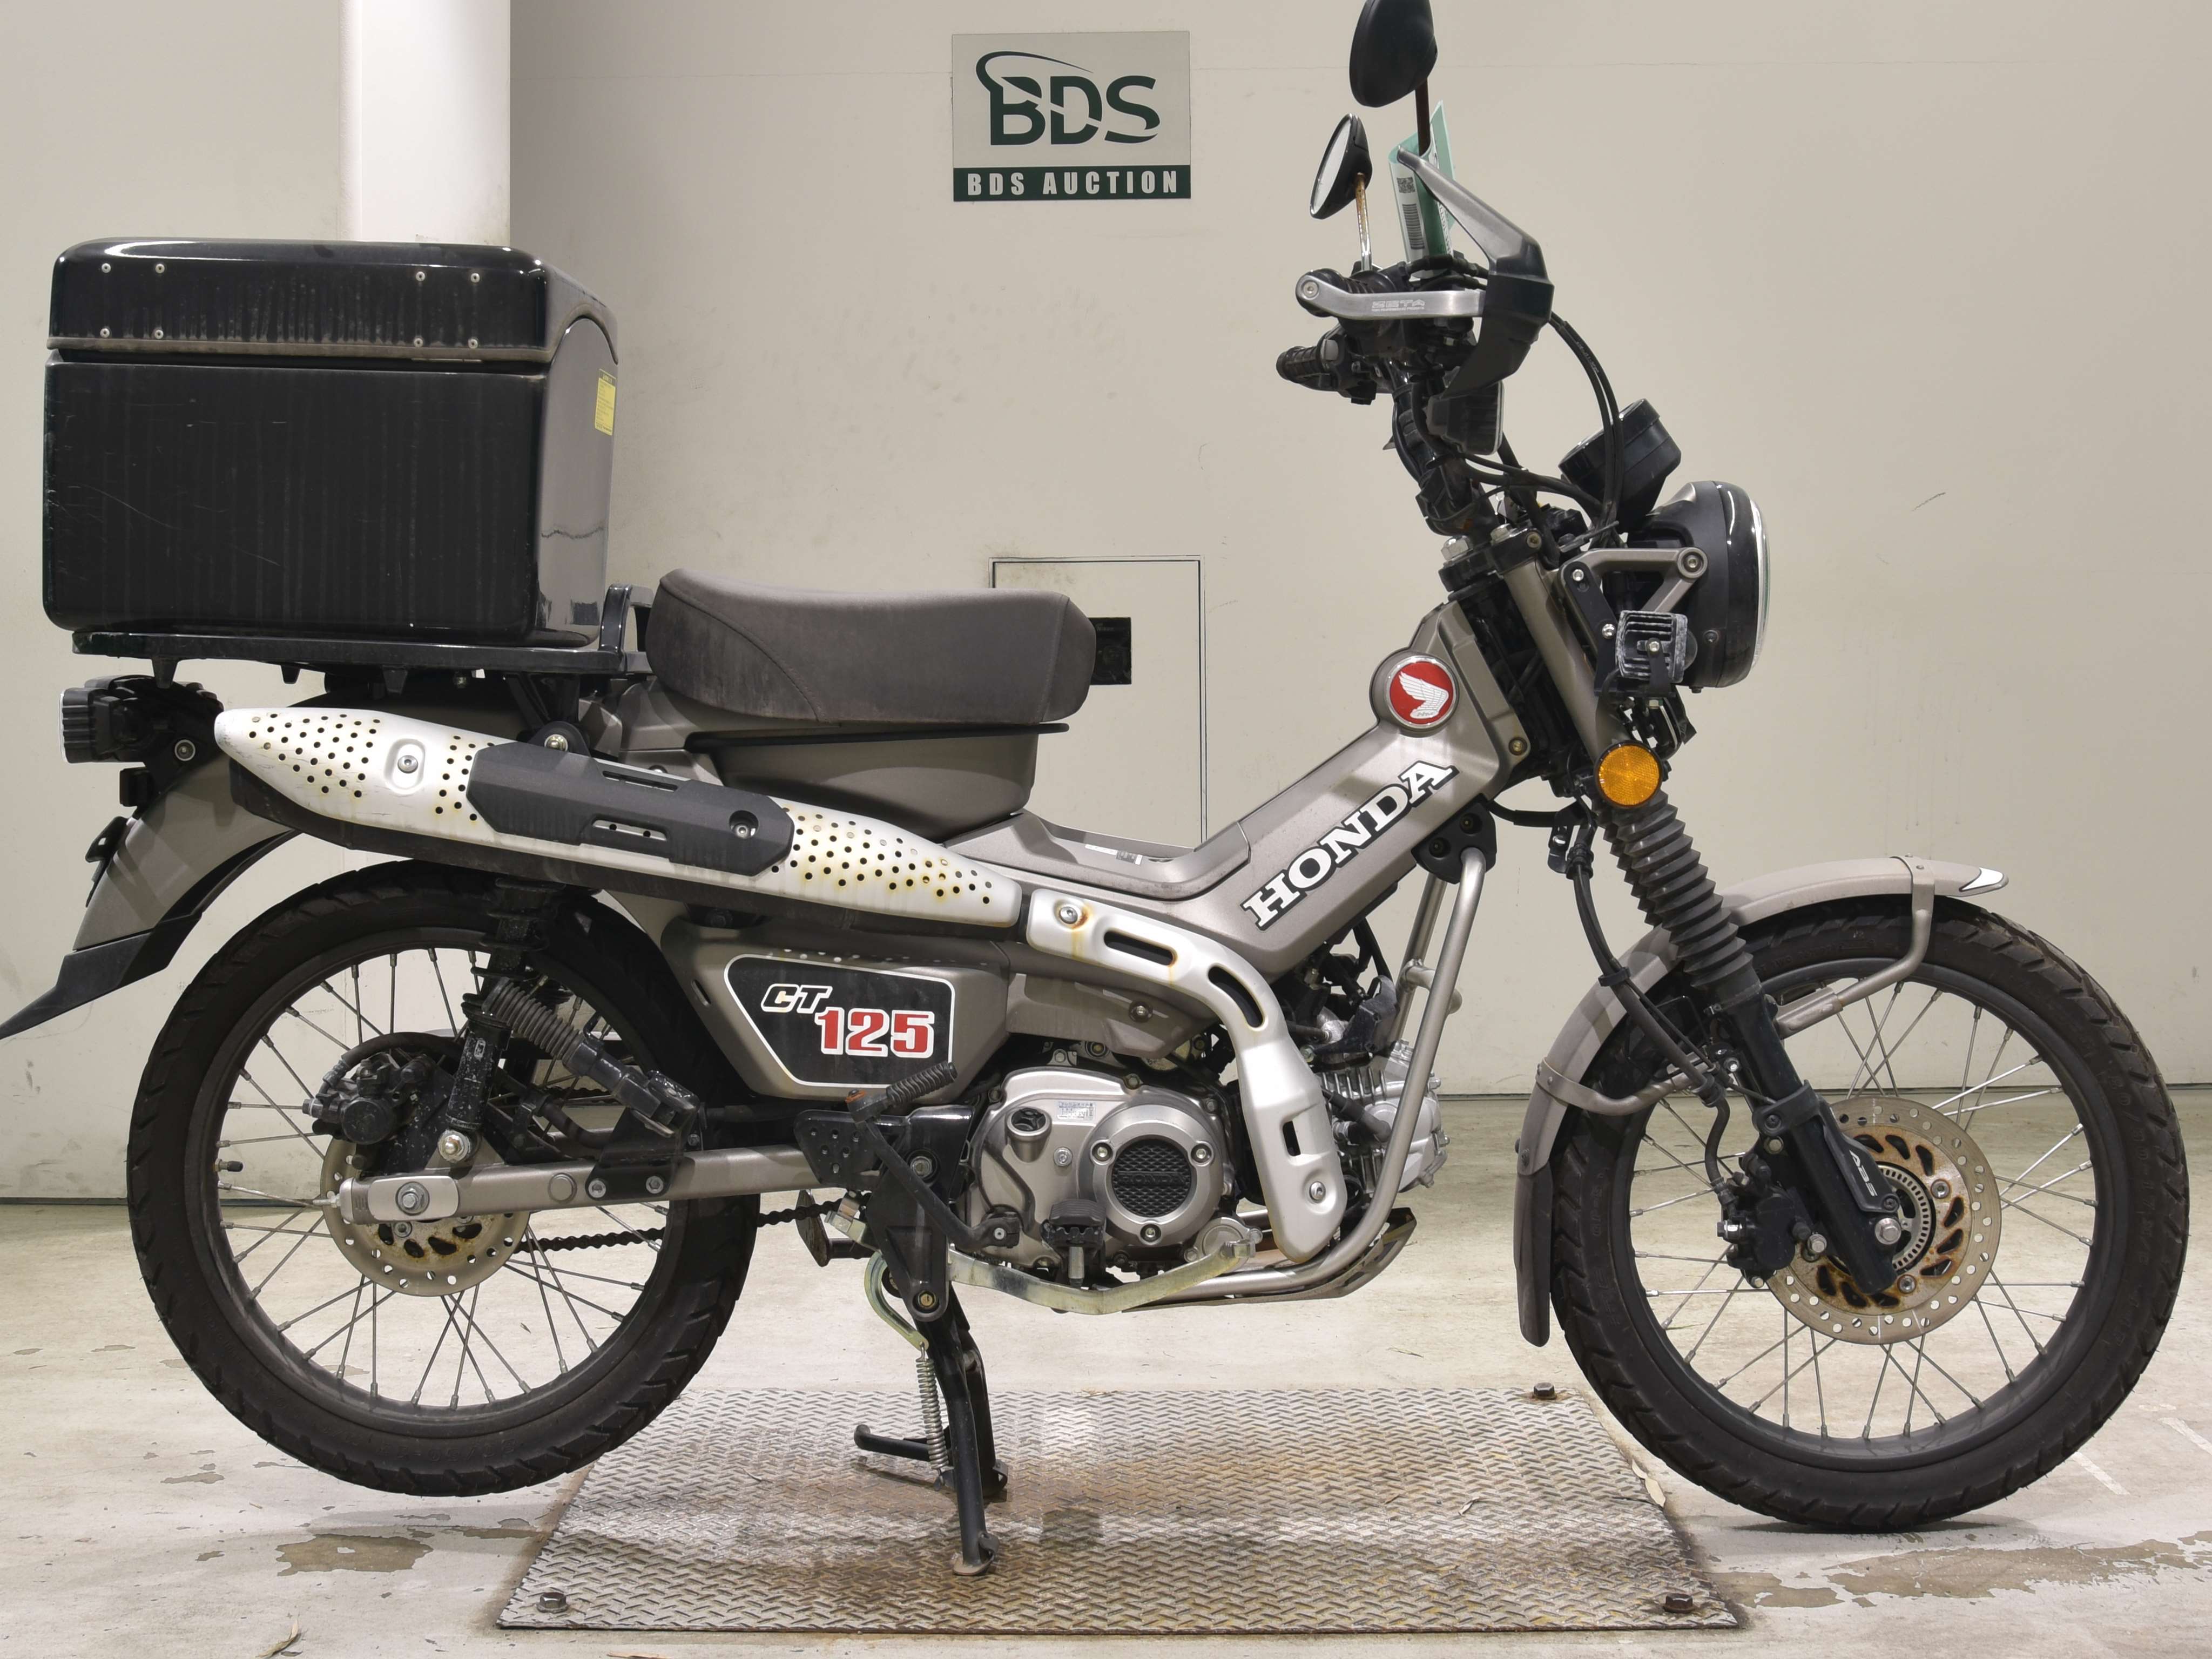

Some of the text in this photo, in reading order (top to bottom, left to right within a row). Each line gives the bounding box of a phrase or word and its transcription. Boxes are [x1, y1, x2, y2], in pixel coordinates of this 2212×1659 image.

[976, 51, 1161, 146] BDS
[967, 170, 1177, 196] BDS AUCTION
[1241, 761, 1457, 929] HONDA
[761, 983, 832, 1014] CT
[814, 1007, 935, 1058] 125
[1118, 1173, 1185, 1183] HONDA
[1849, 1149, 1878, 1197] ABS
